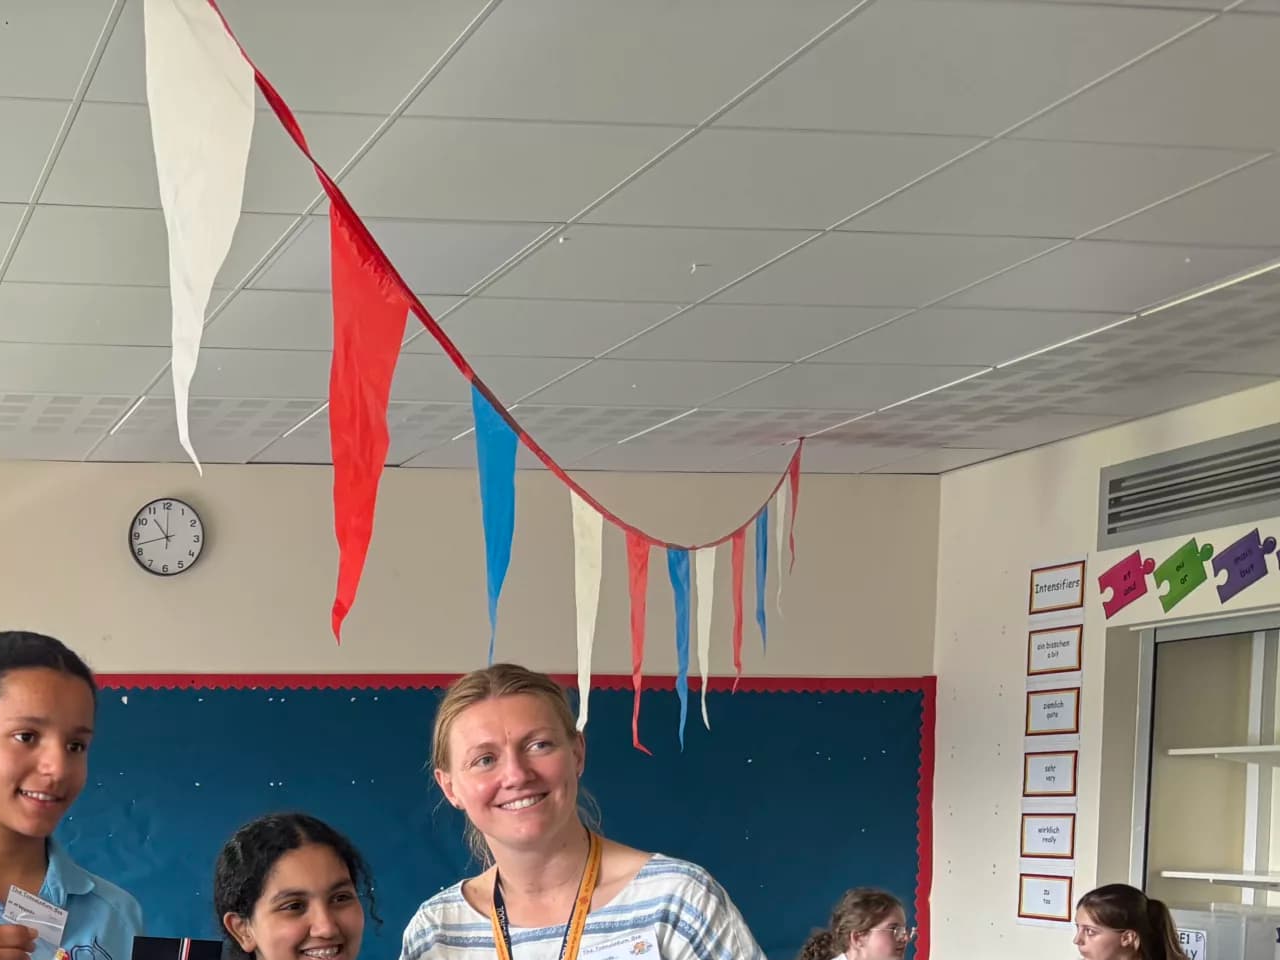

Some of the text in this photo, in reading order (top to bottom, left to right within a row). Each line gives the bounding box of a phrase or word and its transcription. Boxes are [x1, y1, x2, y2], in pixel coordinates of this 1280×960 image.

[148, 507, 156, 515] 11
[163, 502, 173, 511] 12
[181, 508, 185, 516] 1
[138, 518, 148, 526] 10
[189, 519, 197, 528] 2
[133, 532, 140, 541] 9
[193, 535, 200, 543] 3
[137, 547, 143, 556] 8
[147, 559, 154, 567] 7
[177, 560, 184, 569] 5
[162, 564, 169, 573] 6
[1180, 574, 1189, 585] or
[1035, 578, 1081, 594] Intensifiers
